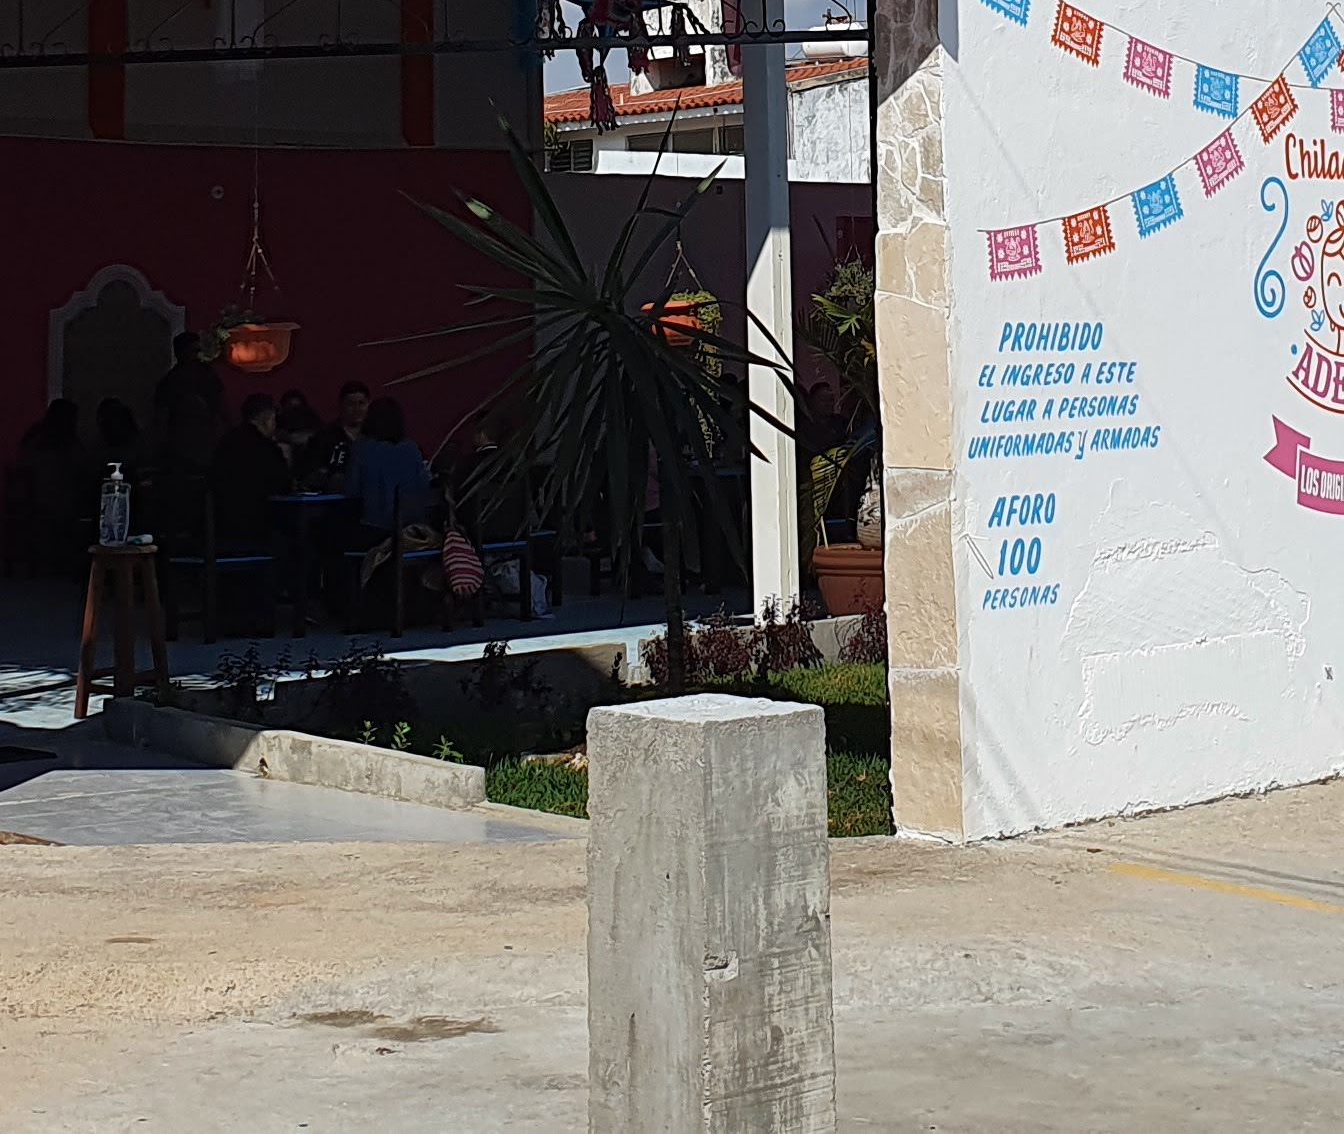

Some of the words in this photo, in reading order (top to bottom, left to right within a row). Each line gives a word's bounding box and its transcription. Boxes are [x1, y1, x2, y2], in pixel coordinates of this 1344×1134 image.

[998, 321, 1103, 352] PROHIBIDO
[978, 364, 996, 387] EL
[1001, 363, 1075, 386] INGRESO
[1080, 363, 1092, 384] A
[1096, 361, 1137, 384] ESTE
[981, 399, 1037, 423] LUGAR
[1042, 398, 1054, 420] A
[1058, 394, 1139, 419] PERSONAS
[968, 431, 1075, 459] UNIFORMADAS
[1090, 425, 1161, 451] ARMADAS
[1300, 464, 1319, 496] LOS
[988, 492, 1056, 528] AFORO
[998, 536, 1042, 576] 100
[982, 583, 1060, 610] PERSONAS
